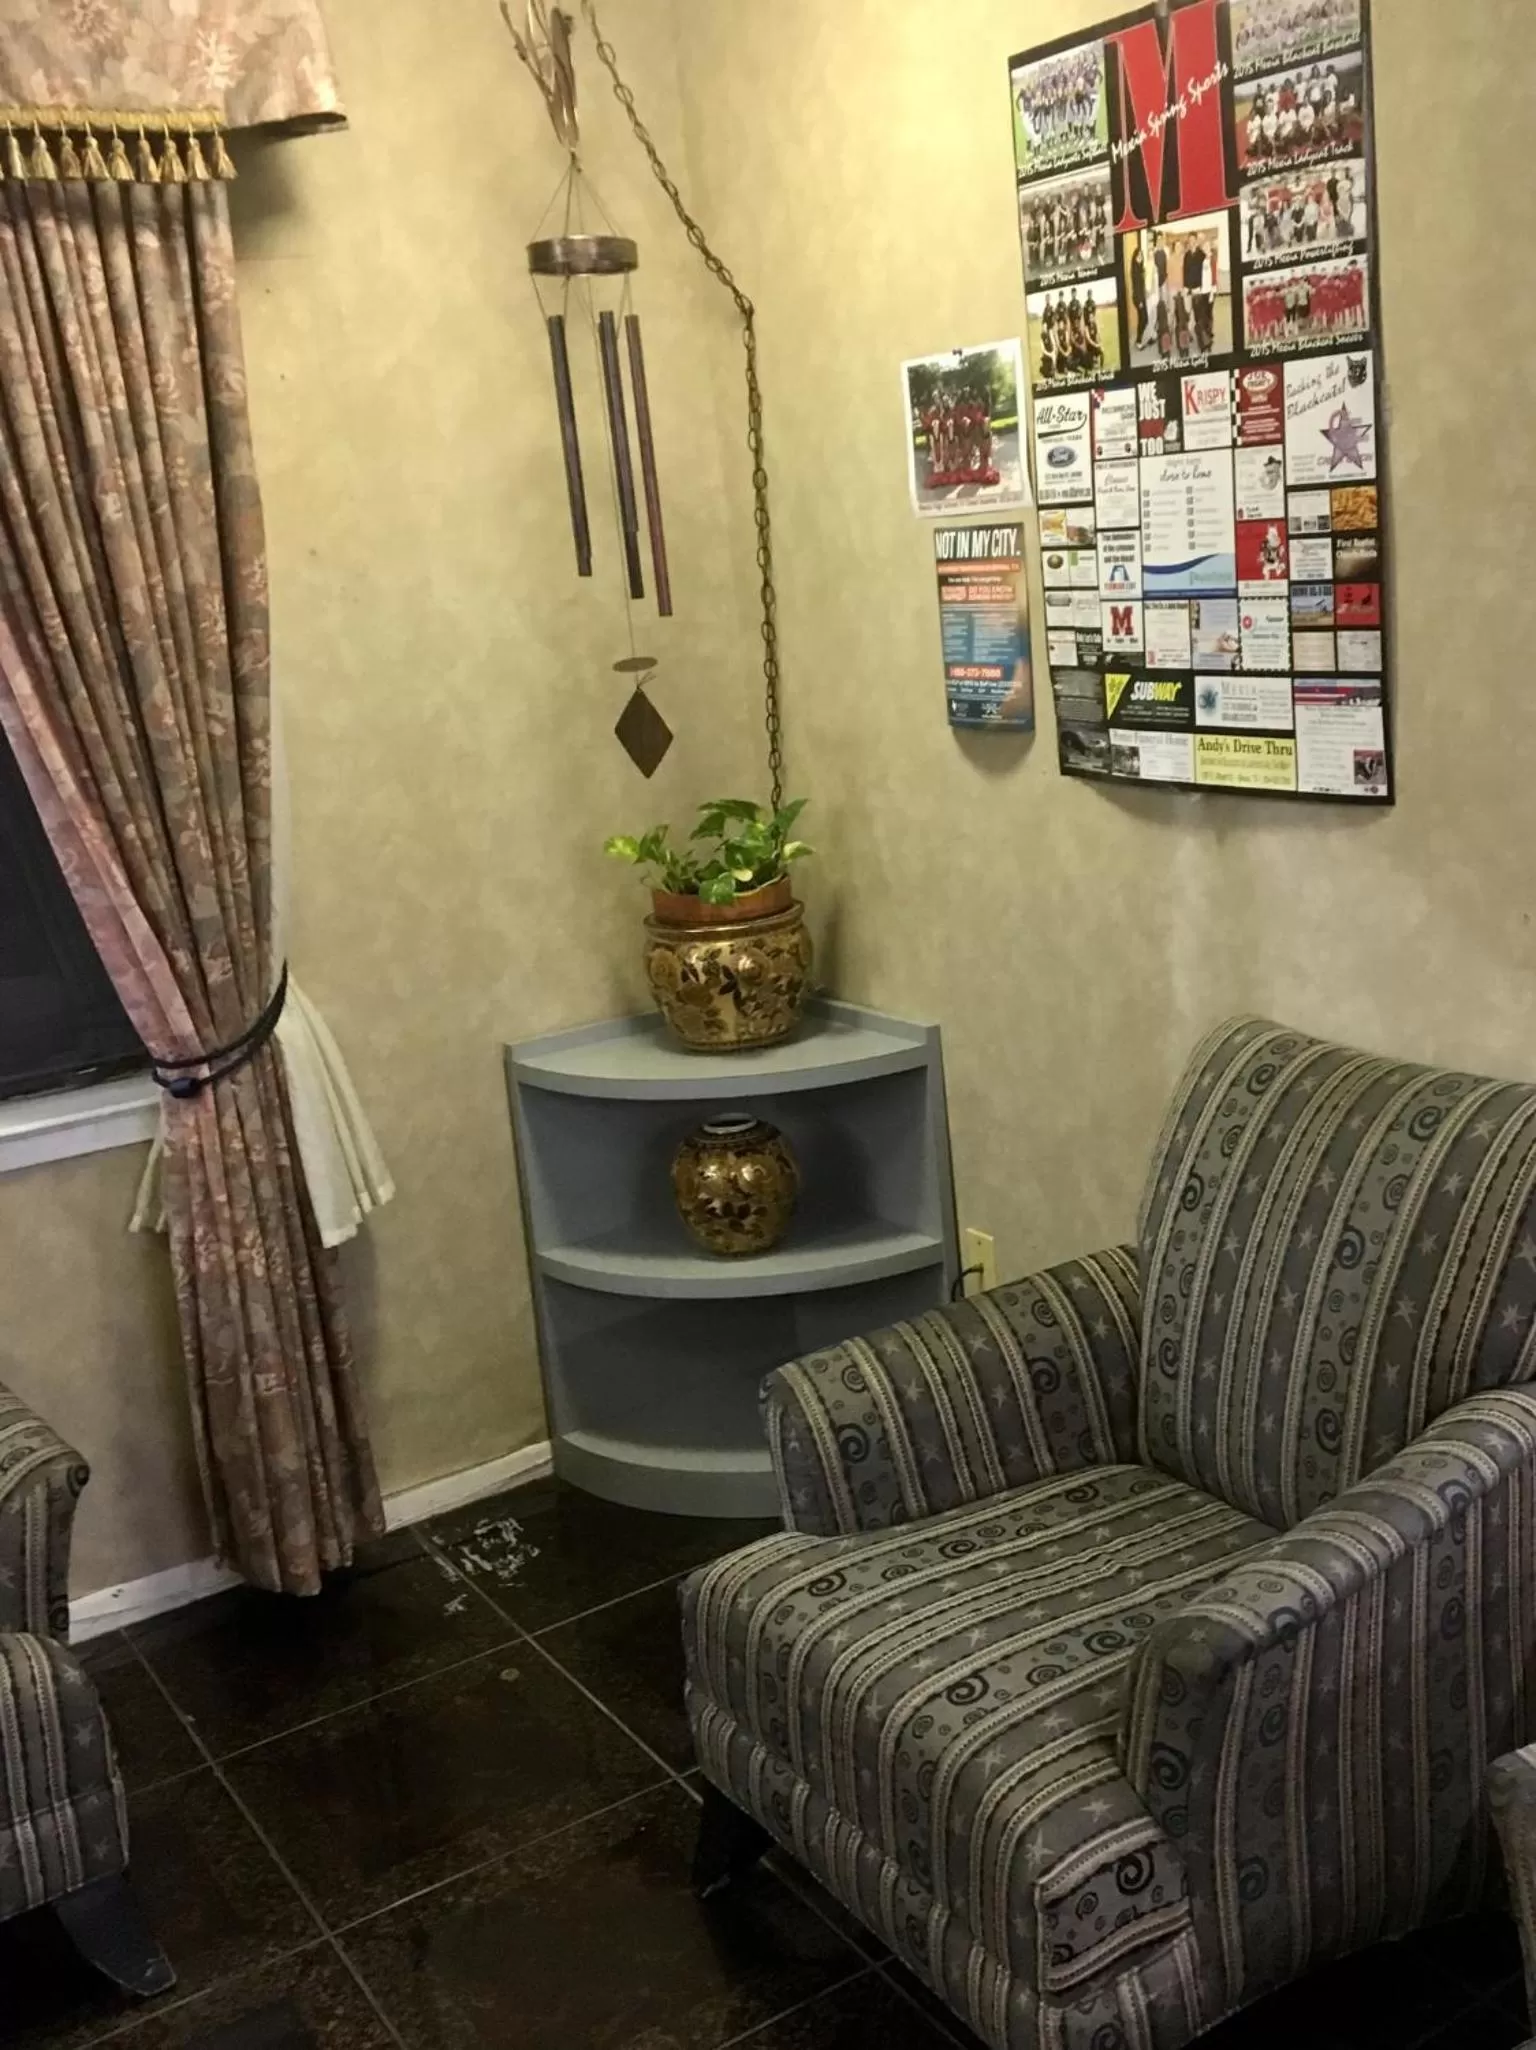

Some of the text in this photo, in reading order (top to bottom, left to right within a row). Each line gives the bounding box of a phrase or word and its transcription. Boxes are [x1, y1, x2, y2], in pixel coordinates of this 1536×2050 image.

[1147, 92, 1188, 138] Spring
[1187, 59, 1229, 106] Sports
[1104, 0, 1240, 234] M
[1137, 381, 1157, 400] WE
[1184, 380, 1226, 417] KRISPY
[1138, 398, 1166, 420] JUST
[1140, 436, 1164, 456] TOO
[935, 527, 1021, 559] NOT IN MY CITY.
[1109, 605, 1134, 636] M
[1130, 680, 1182, 701] SUBWAY
[1197, 736, 1293, 756] Andy's Drive Thru
